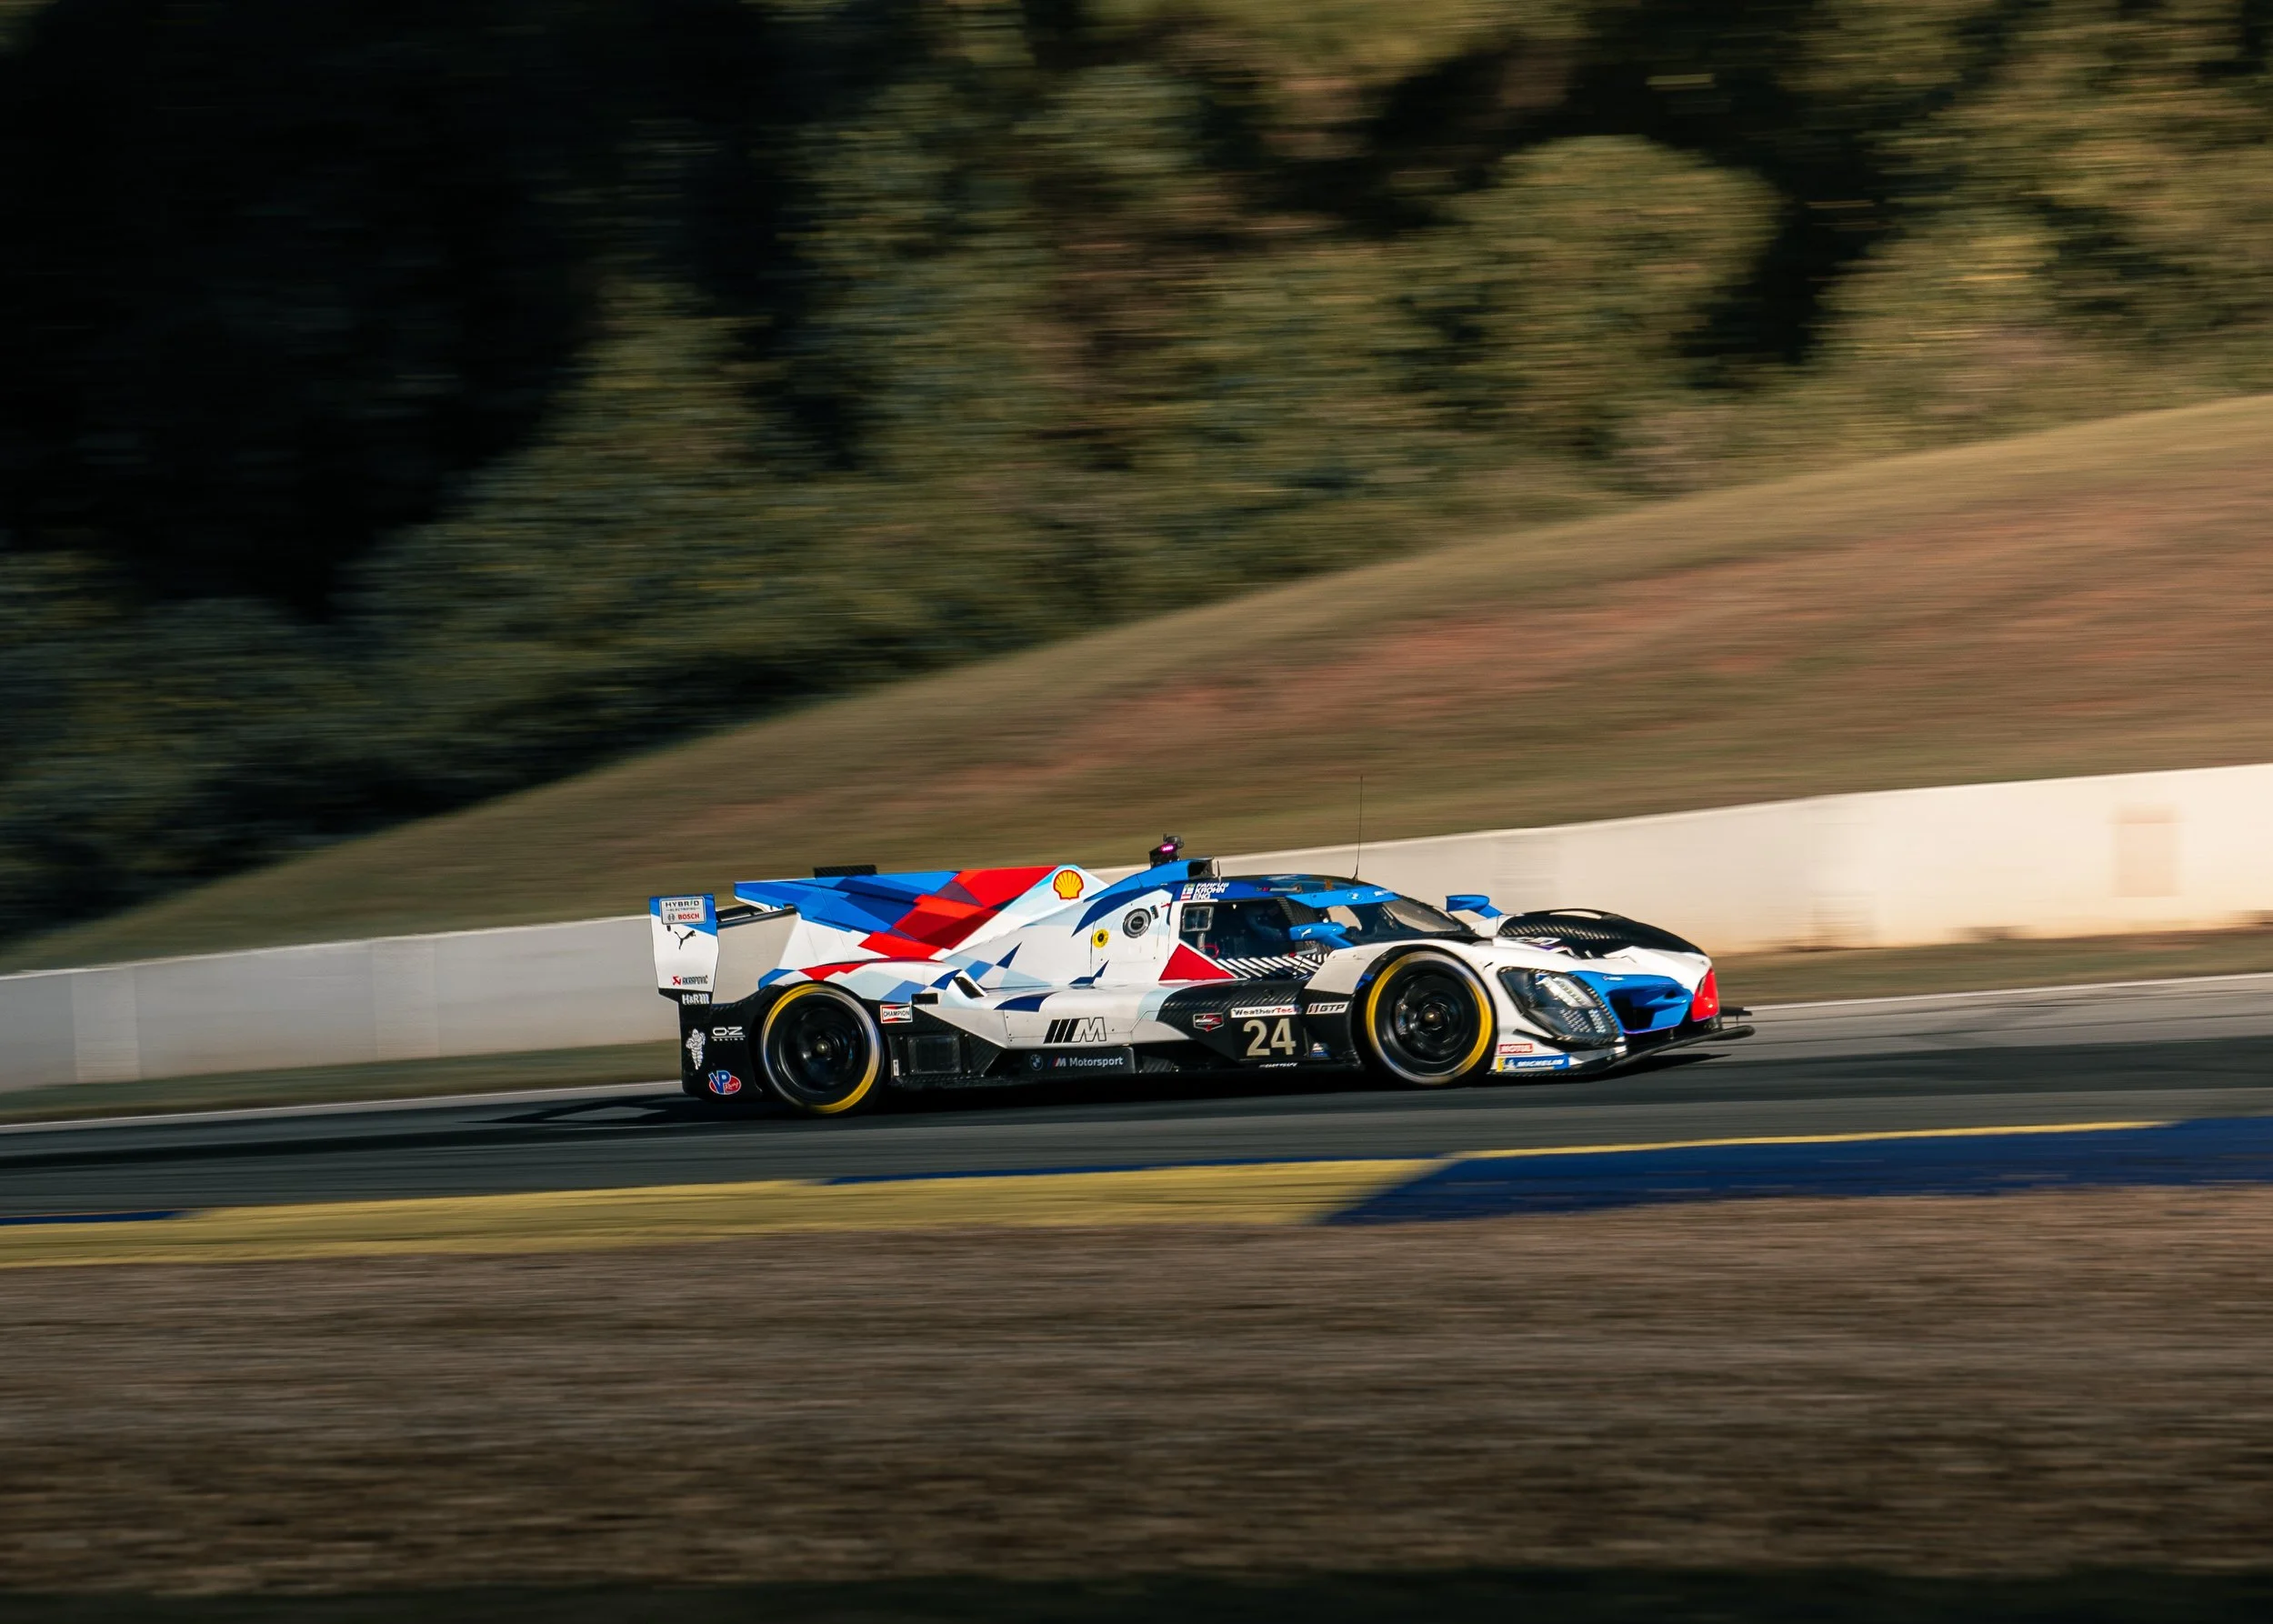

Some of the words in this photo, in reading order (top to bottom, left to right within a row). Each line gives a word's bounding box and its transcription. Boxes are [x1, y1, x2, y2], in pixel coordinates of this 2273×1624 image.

[1195, 886, 1227, 894] KROHN
[1192, 892, 1210, 900] ENG
[665, 900, 700, 908] HYBRID
[1320, 1003, 1346, 1012] GTP
[883, 1009, 910, 1018] CHAMPION
[1243, 1018, 1297, 1057] 24
[1069, 1056, 1124, 1068] Motorsport
[1517, 1058, 1565, 1068] MICHELIN
[708, 1070, 732, 1095] VP
